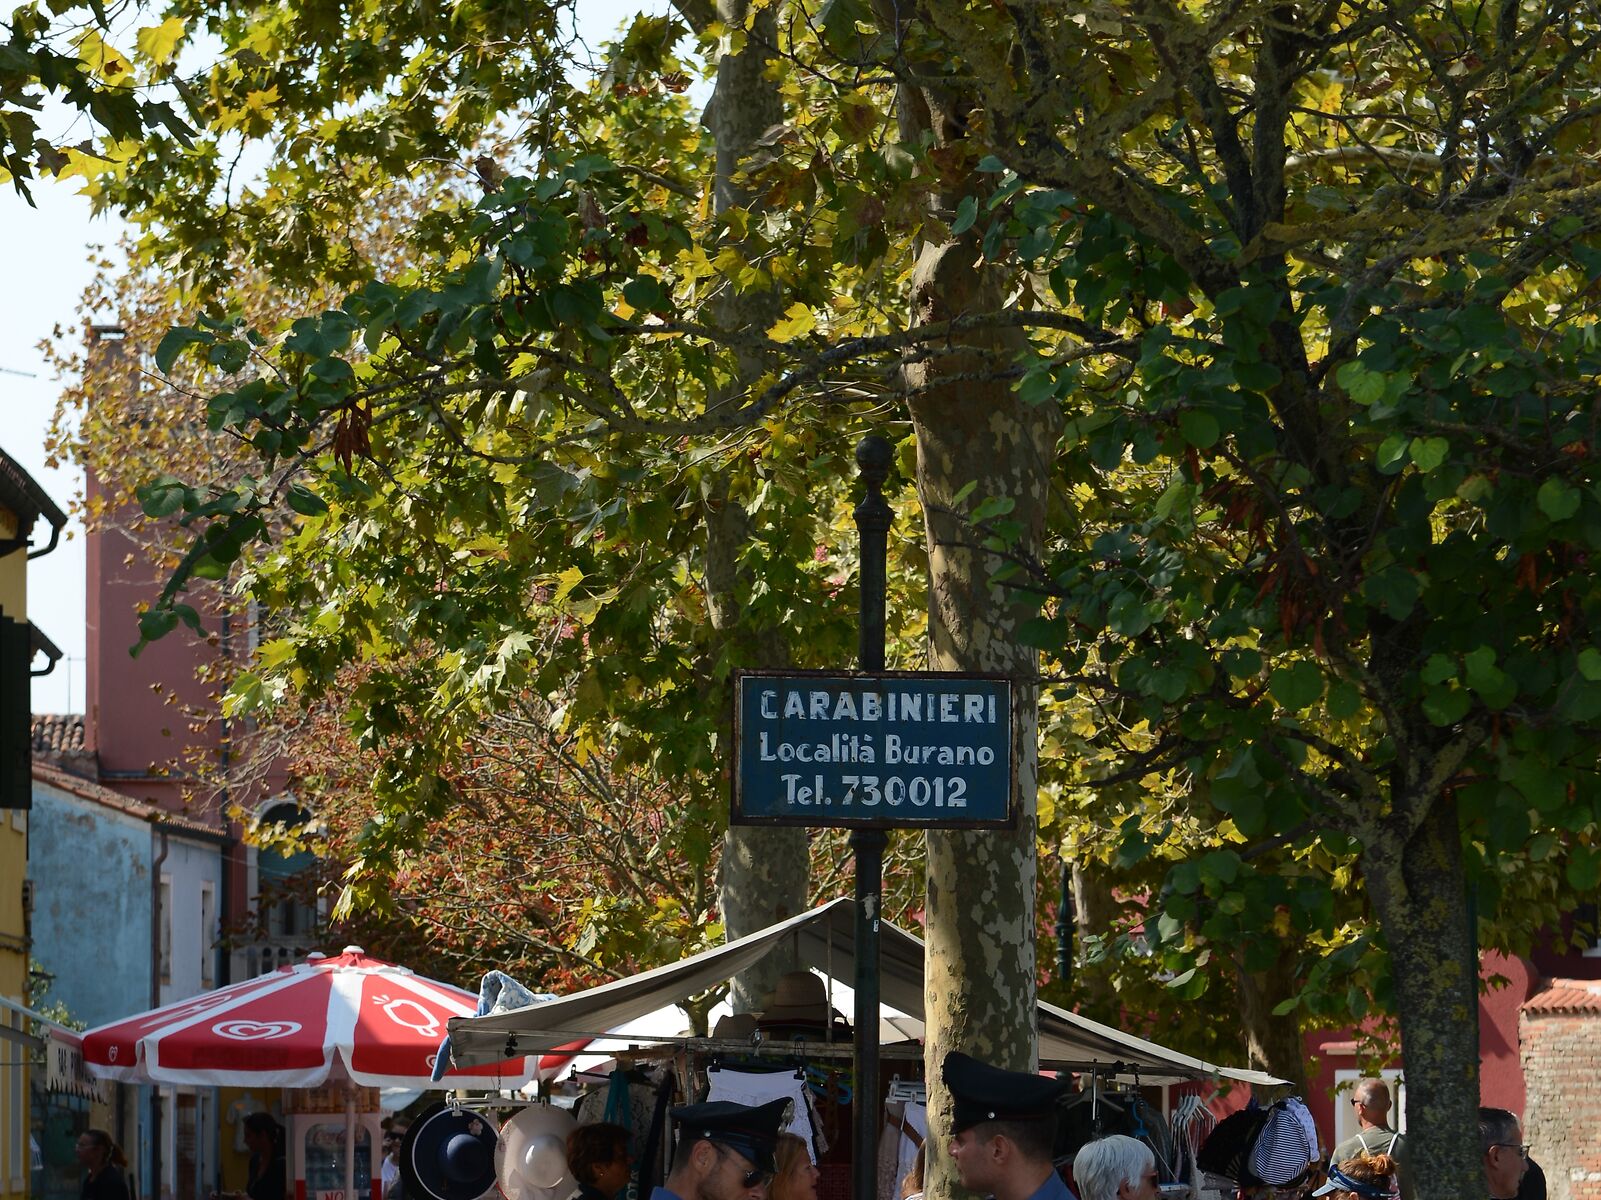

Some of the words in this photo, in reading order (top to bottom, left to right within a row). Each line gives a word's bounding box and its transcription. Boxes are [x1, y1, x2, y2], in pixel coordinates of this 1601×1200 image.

[760, 689, 996, 724] CARABINIERI
[759, 731, 875, 764] Località
[885, 733, 995, 766] Burano
[781, 774, 832, 805] Tel.
[841, 775, 967, 808] 730012
